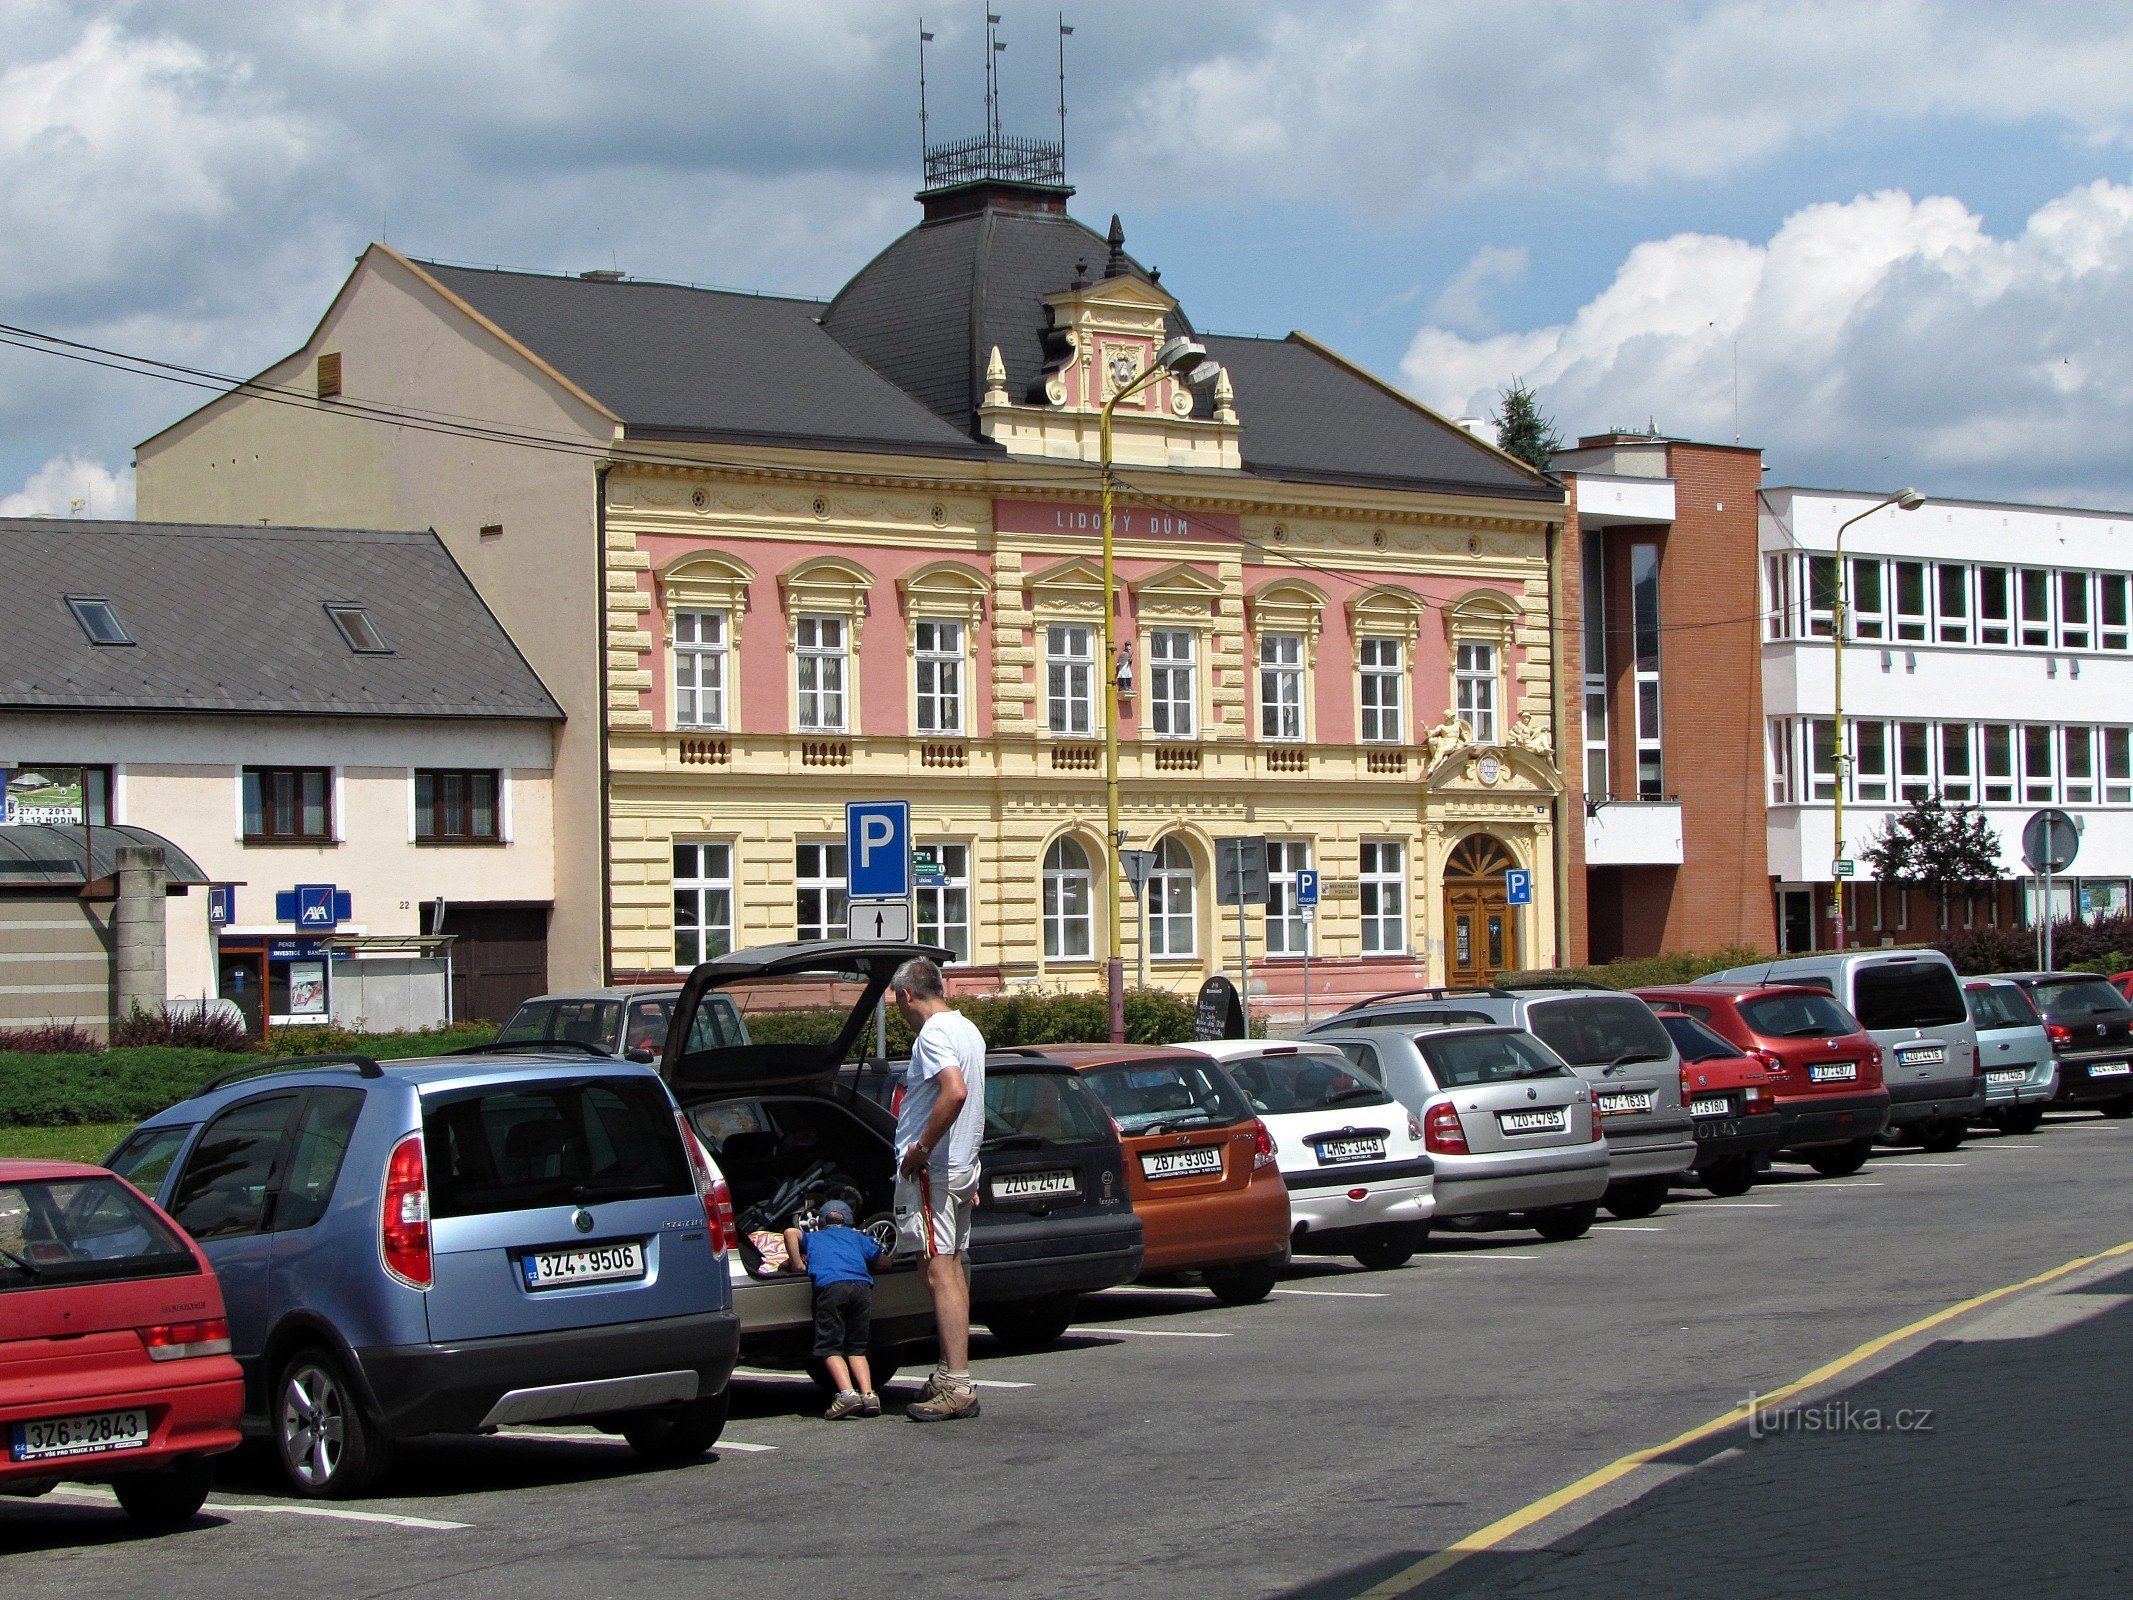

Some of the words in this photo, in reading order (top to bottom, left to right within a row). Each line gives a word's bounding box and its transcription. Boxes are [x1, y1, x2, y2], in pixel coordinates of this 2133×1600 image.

[1150, 512, 1187, 535] DŮM
[861, 814, 894, 867] P
[1302, 874, 1312, 893] P
[1511, 874, 1525, 894] P
[303, 905, 328, 920] AXA
[399, 901, 410, 910] 22
[1603, 1097, 1617, 1109] 4Z7
[1627, 1095, 1647, 1107] 1639
[1705, 1100, 1724, 1113] 6180
[1511, 1114, 1528, 1128] 1Z0
[1536, 1111, 1559, 1125] 4795
[1328, 1141, 1346, 1156] 4M6
[1354, 1138, 1378, 1153] 3448
[1153, 1154, 1175, 1171] 2B7
[1185, 1150, 1214, 1166] 9309
[1039, 1172, 1069, 1190] 2472
[540, 1254, 576, 1277] 3Z4
[588, 1246, 634, 1271] 9506
[31, 1422, 71, 1448] 3Z6
[87, 1414, 138, 1442] 2843
[69, 1447, 88, 1455] TRUCK
